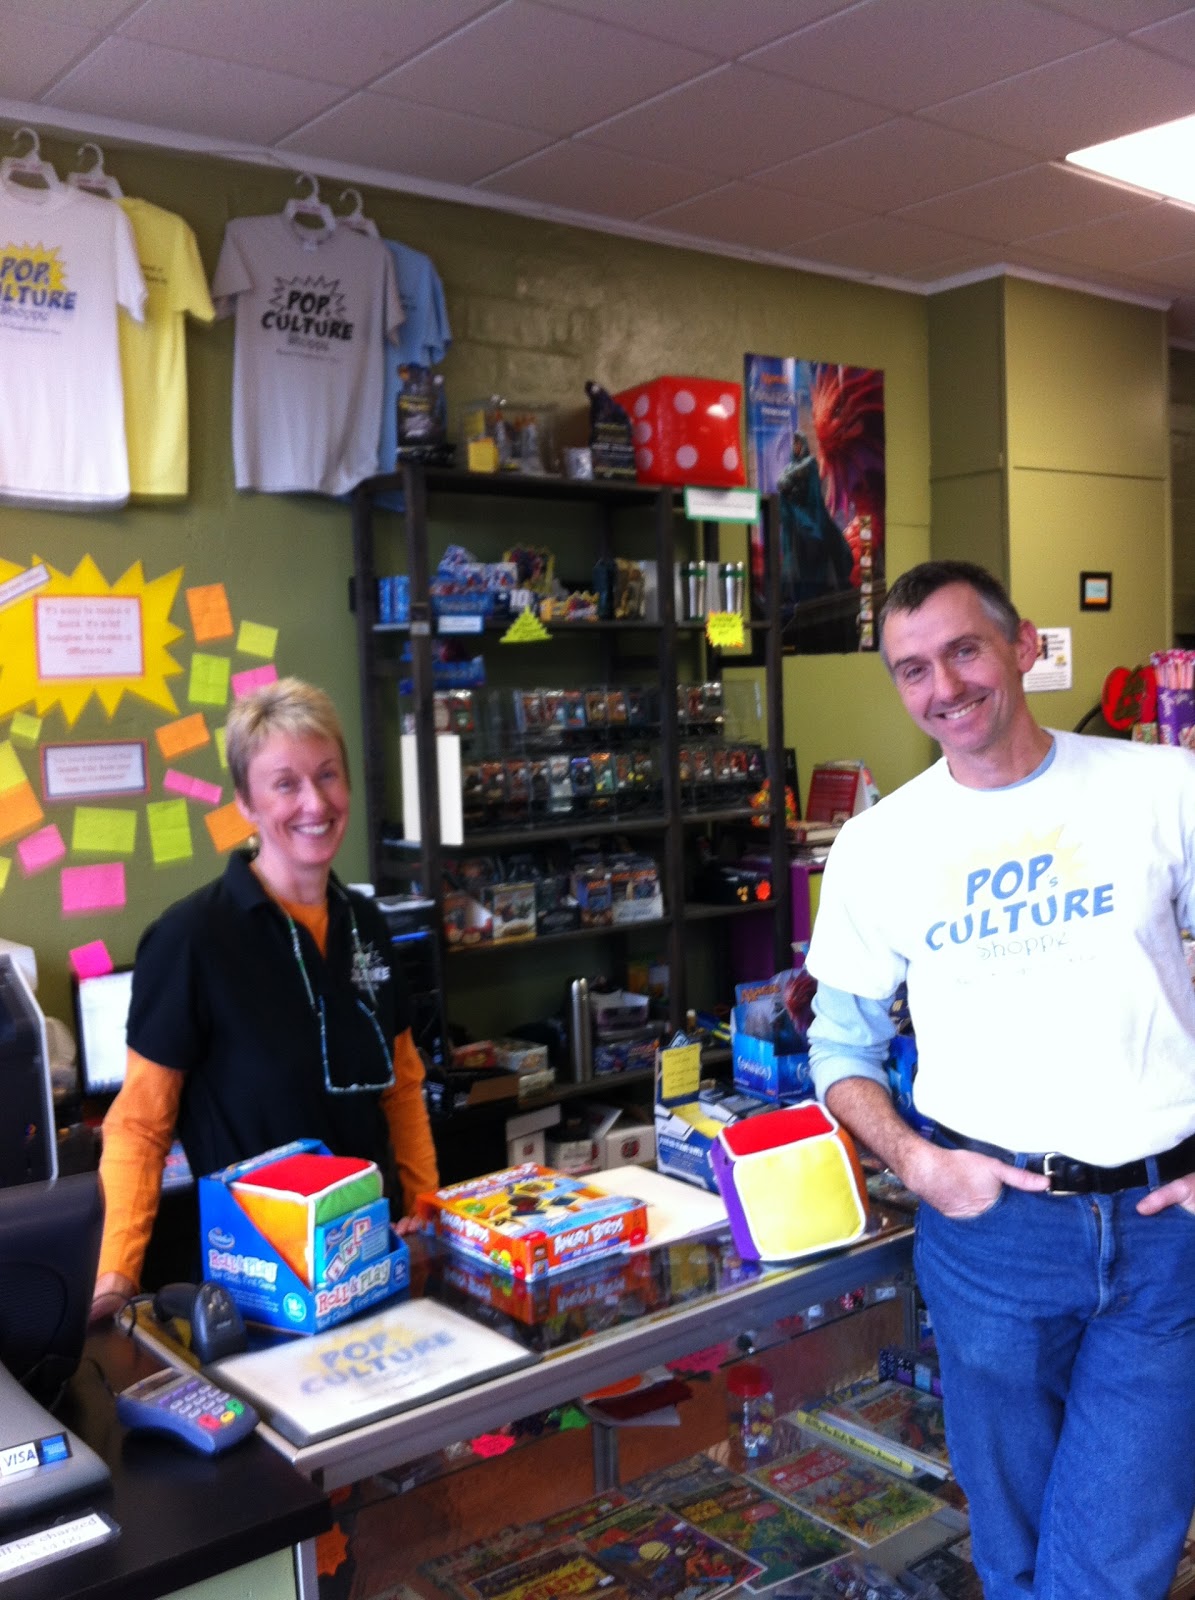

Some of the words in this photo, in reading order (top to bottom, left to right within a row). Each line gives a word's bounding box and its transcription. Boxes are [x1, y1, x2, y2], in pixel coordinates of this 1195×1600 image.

[0, 283, 77, 310] LTURE
[261, 310, 354, 341] CULTURE
[925, 882, 1115, 952] CULTURE
[553, 1228, 591, 1256] ANGRY
[591, 1216, 625, 1243] BIRDS
[300, 1329, 455, 1397] CULTURE
[3, 1449, 37, 1467] VISA
[40, 1516, 98, 1543] charged
